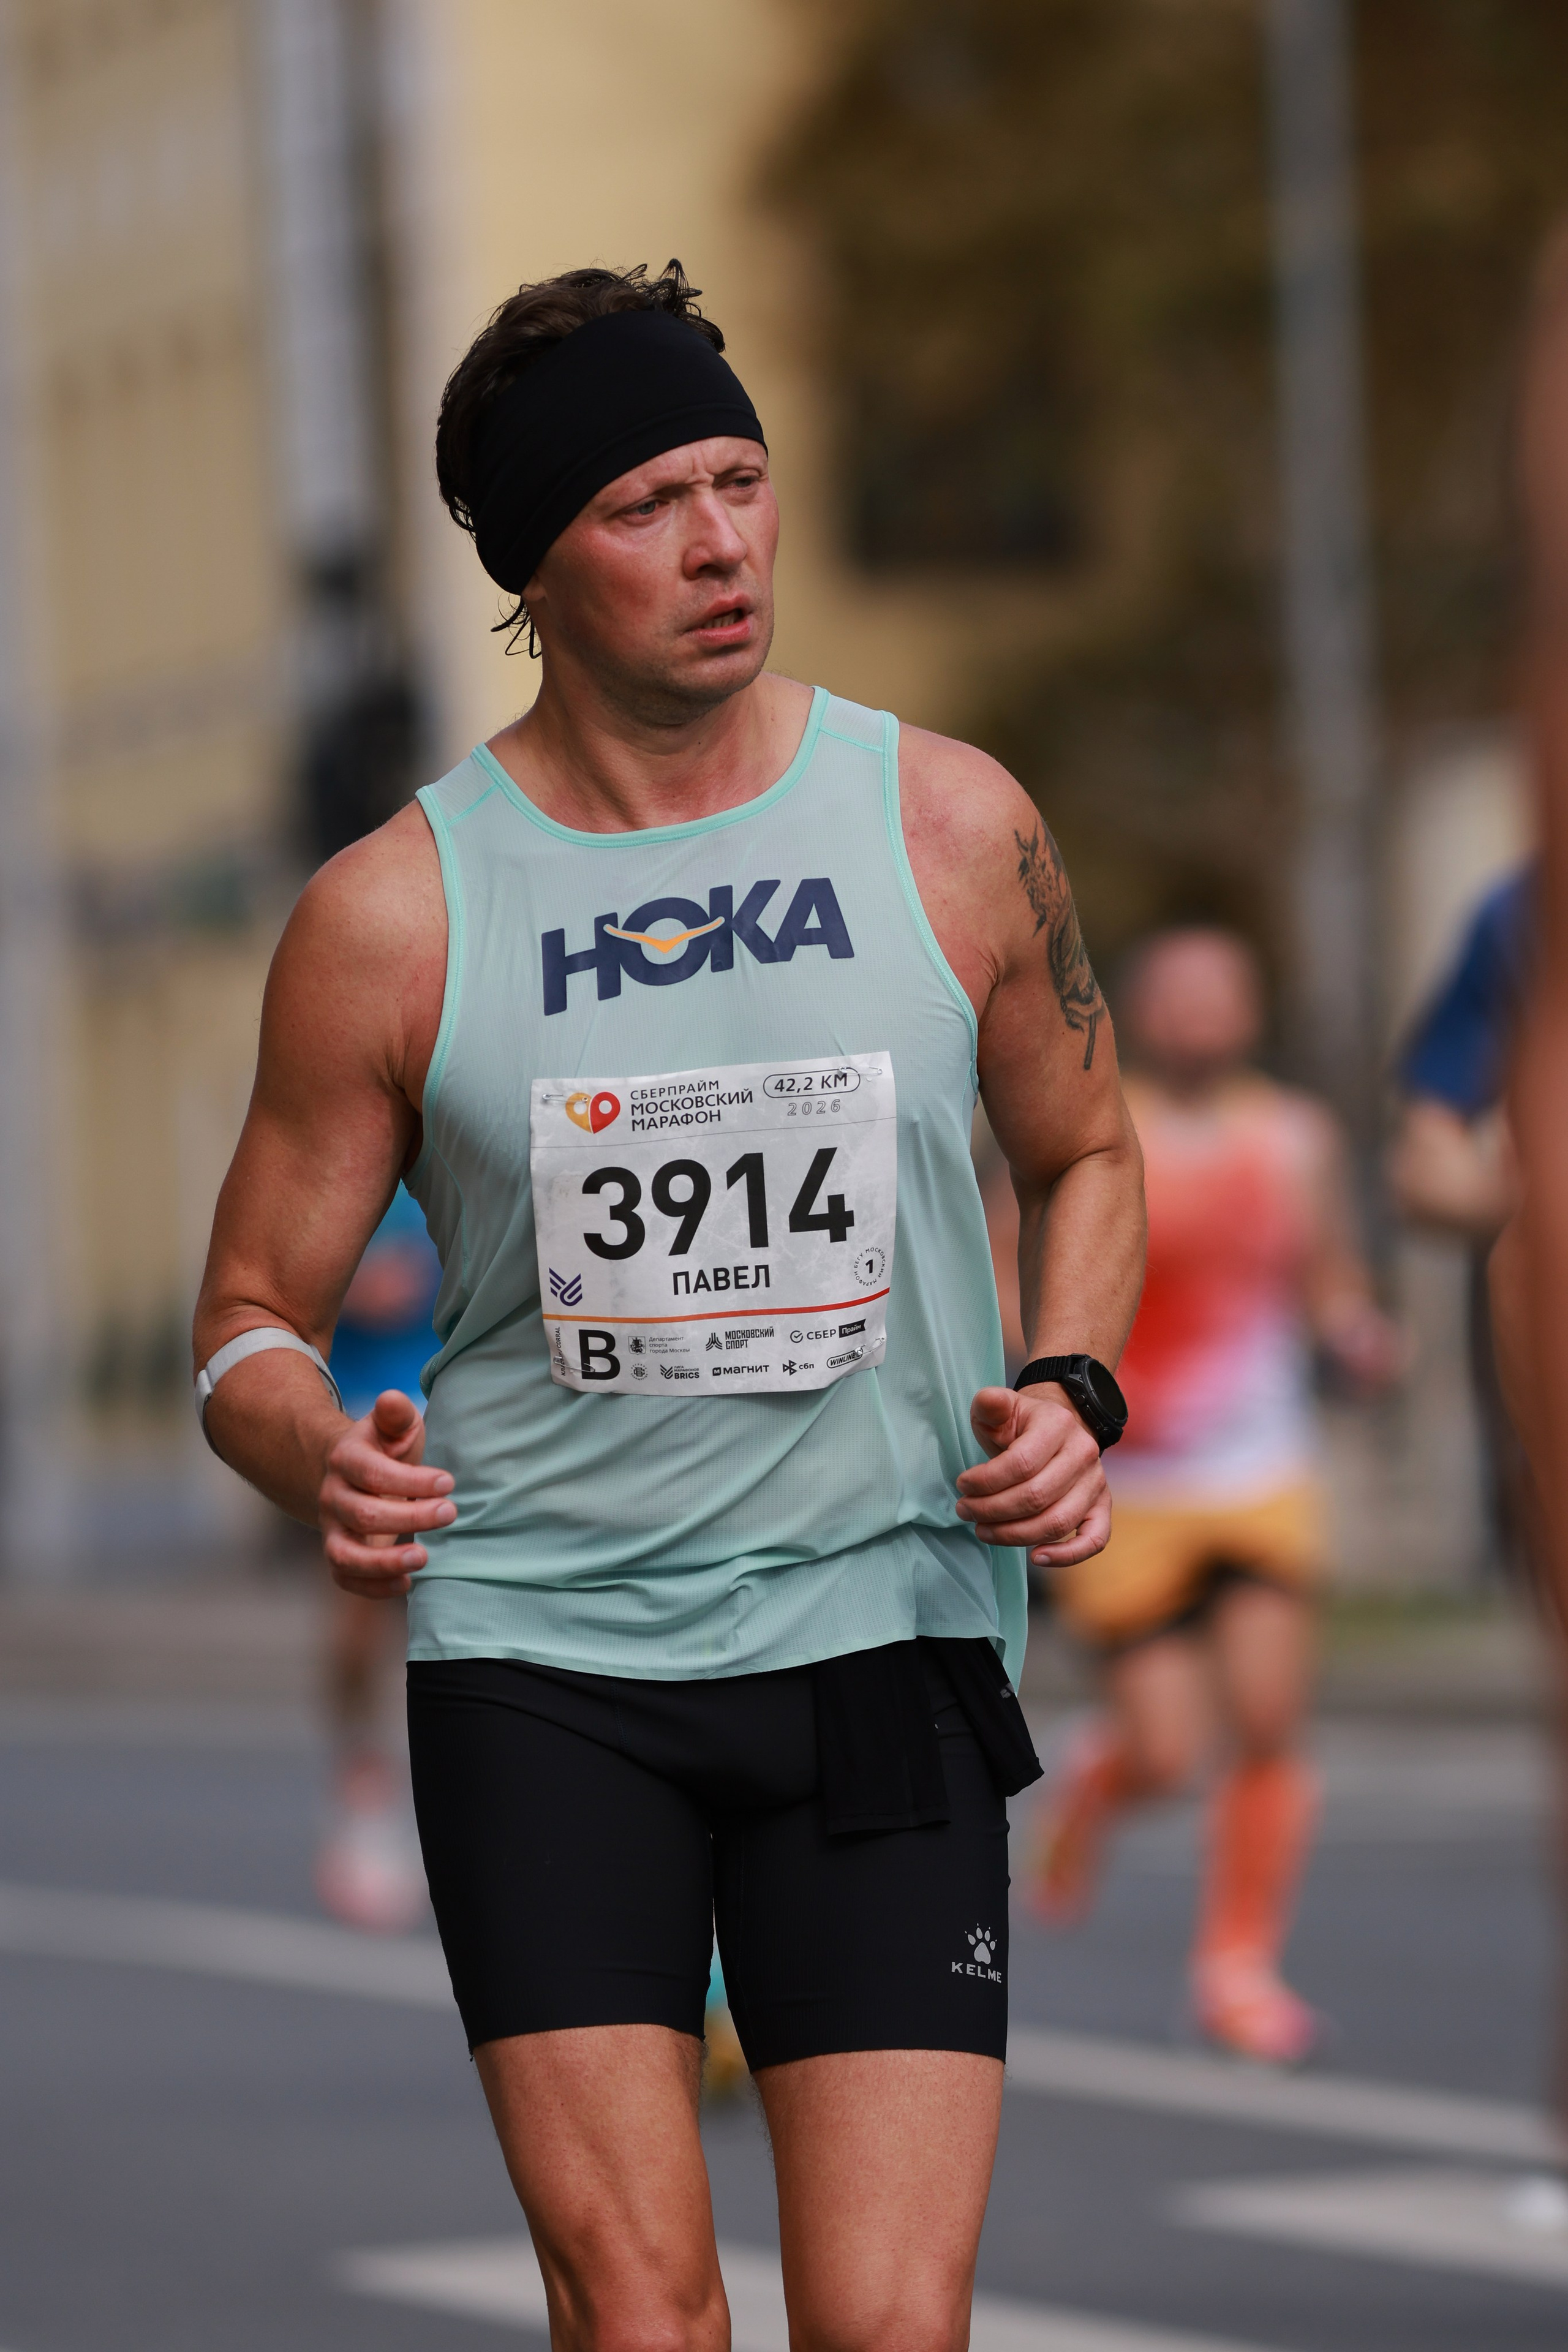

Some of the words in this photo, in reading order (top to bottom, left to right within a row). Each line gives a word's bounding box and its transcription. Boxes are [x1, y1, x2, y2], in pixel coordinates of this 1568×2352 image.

[541, 878, 855, 1016] HOKA
[630, 1080, 719, 1100] СБЕРПРАЙМ
[774, 1077, 813, 1093] 42,2
[821, 1073, 847, 1089] КМ
[631, 1088, 753, 1116] МОСКОВСКИЙ
[787, 1099, 840, 1116] 2026
[631, 1109, 721, 1131] МАРАФОН
[582, 1147, 854, 1261] 3914
[865, 1259, 873, 1273] 1
[673, 1264, 771, 1295] ПАВЕЛ
[725, 1326, 774, 1340] МОСКОВСКИЙ
[807, 1329, 836, 1340] СБЕР
[842, 1324, 861, 1334] Прайм
[578, 1329, 620, 1380] B
[726, 1340, 748, 1349] СПОРТ
[830, 1352, 856, 1366] WINLINE
[723, 1365, 769, 1374] магнит
[951, 1962, 1001, 1983] KELME
